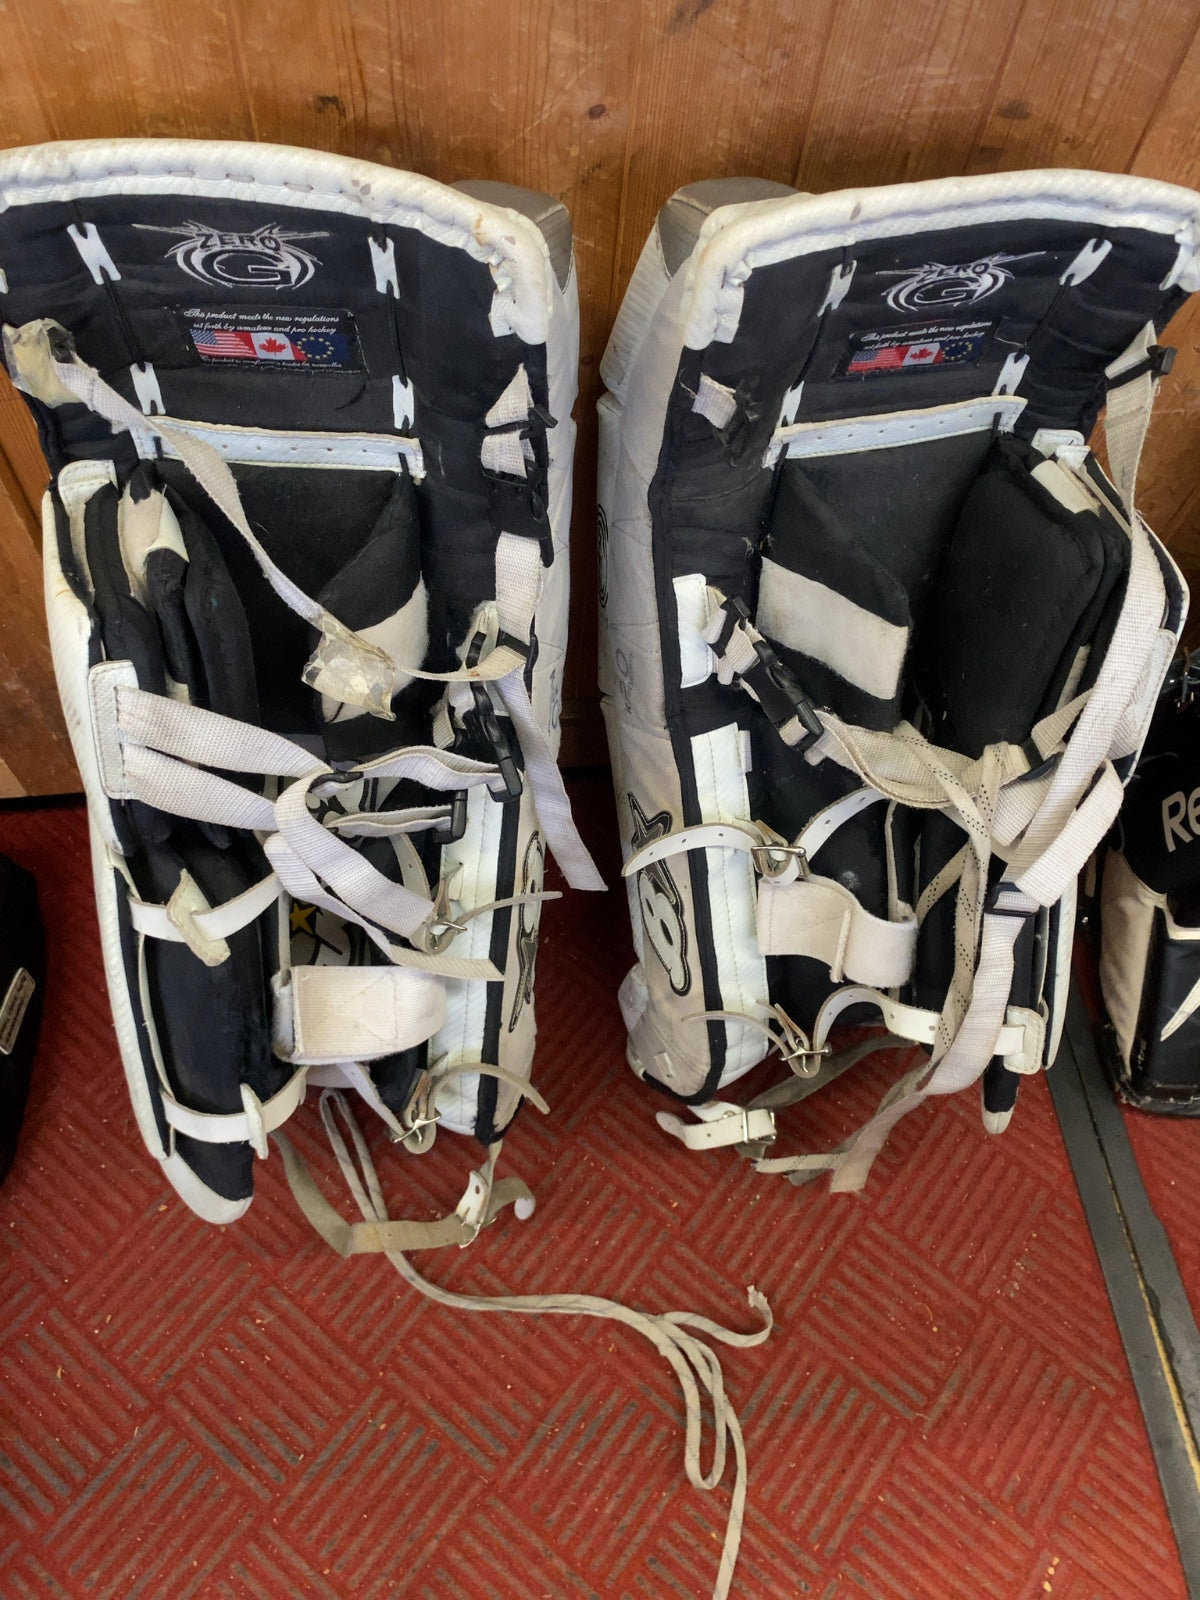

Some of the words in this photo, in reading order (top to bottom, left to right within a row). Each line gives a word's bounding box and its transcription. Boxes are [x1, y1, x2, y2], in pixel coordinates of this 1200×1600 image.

[195, 232, 282, 251] ZERO
[184, 308, 205, 318] This
[205, 311, 238, 321] product
[239, 312, 261, 321] meets
[261, 311, 274, 321] the
[294, 315, 340, 325] regulations
[202, 322, 222, 331] forth
[223, 323, 236, 332] by
[273, 325, 291, 333] and
[290, 326, 306, 335] pro
[307, 326, 336, 335] hockey
